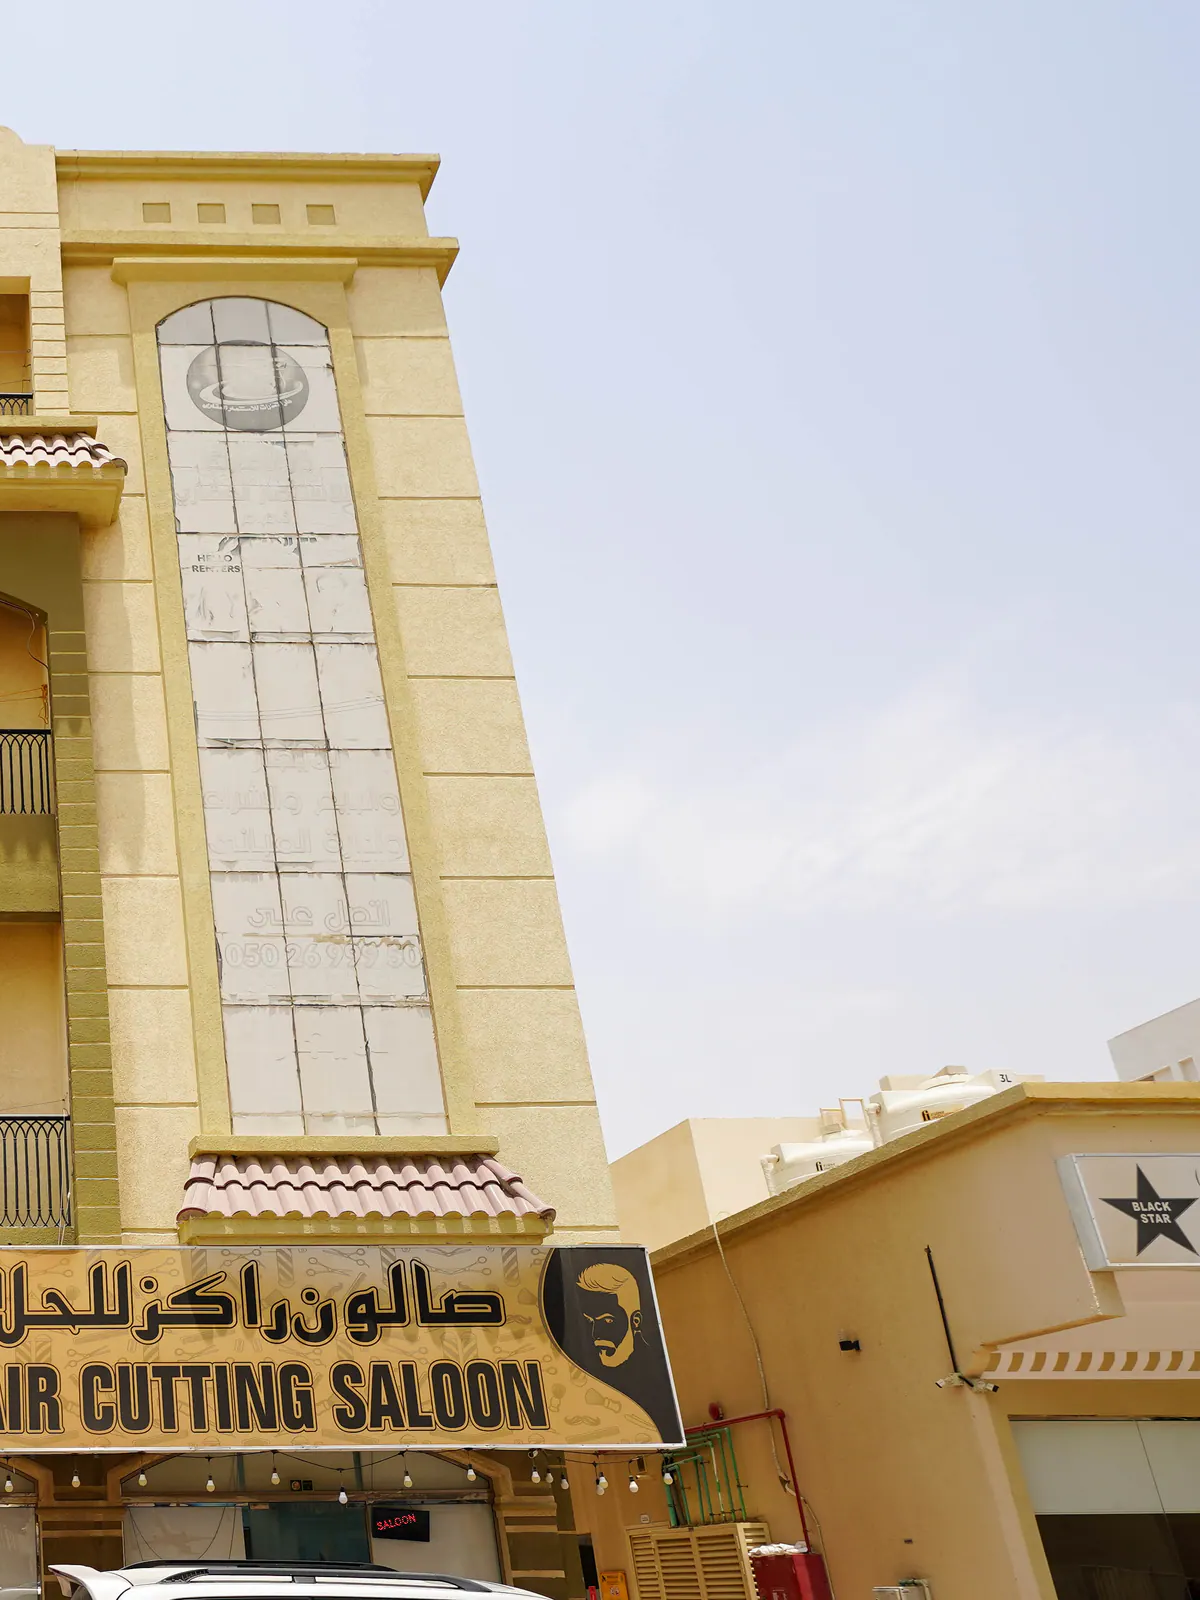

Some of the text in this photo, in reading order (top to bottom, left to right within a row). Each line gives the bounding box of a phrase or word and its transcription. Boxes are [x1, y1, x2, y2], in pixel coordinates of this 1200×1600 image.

[192, 565, 240, 573] RENERS
[999, 1074, 1012, 1083] 3L
[1131, 1201, 1172, 1212] BLACK
[1140, 1213, 1172, 1224] STAR
[289, 1258, 507, 1347] صالون
[79, 1361, 318, 1435] CUTTING
[328, 1359, 551, 1433] SALOON
[376, 1513, 417, 1531] SALOON
